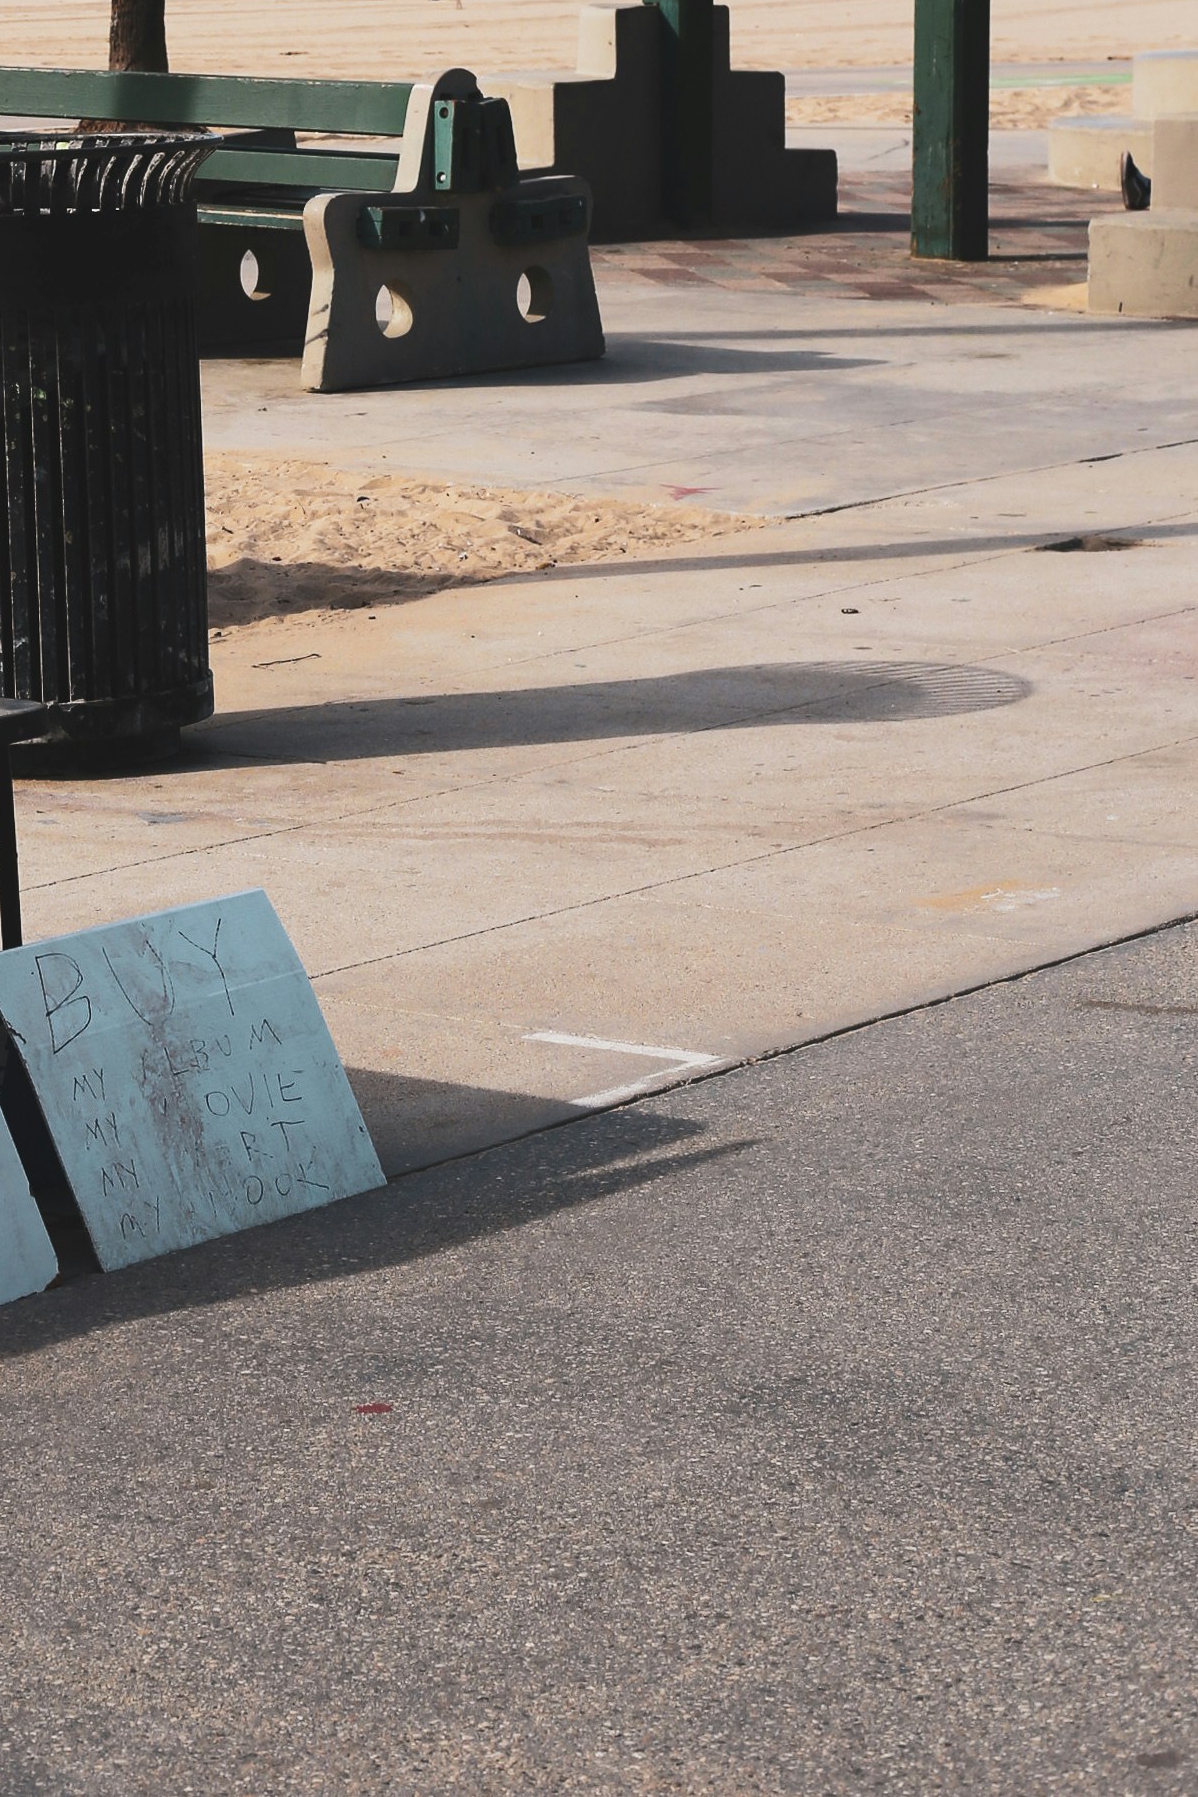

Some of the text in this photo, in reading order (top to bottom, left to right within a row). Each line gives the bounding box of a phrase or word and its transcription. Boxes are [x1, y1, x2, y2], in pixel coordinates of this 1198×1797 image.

[35, 918, 234, 1054] BUY
[73, 1067, 106, 1101] MY
[84, 1070, 304, 1150] MY OVIE
[101, 1159, 140, 1197] MY
[120, 1195, 160, 1239] MY
